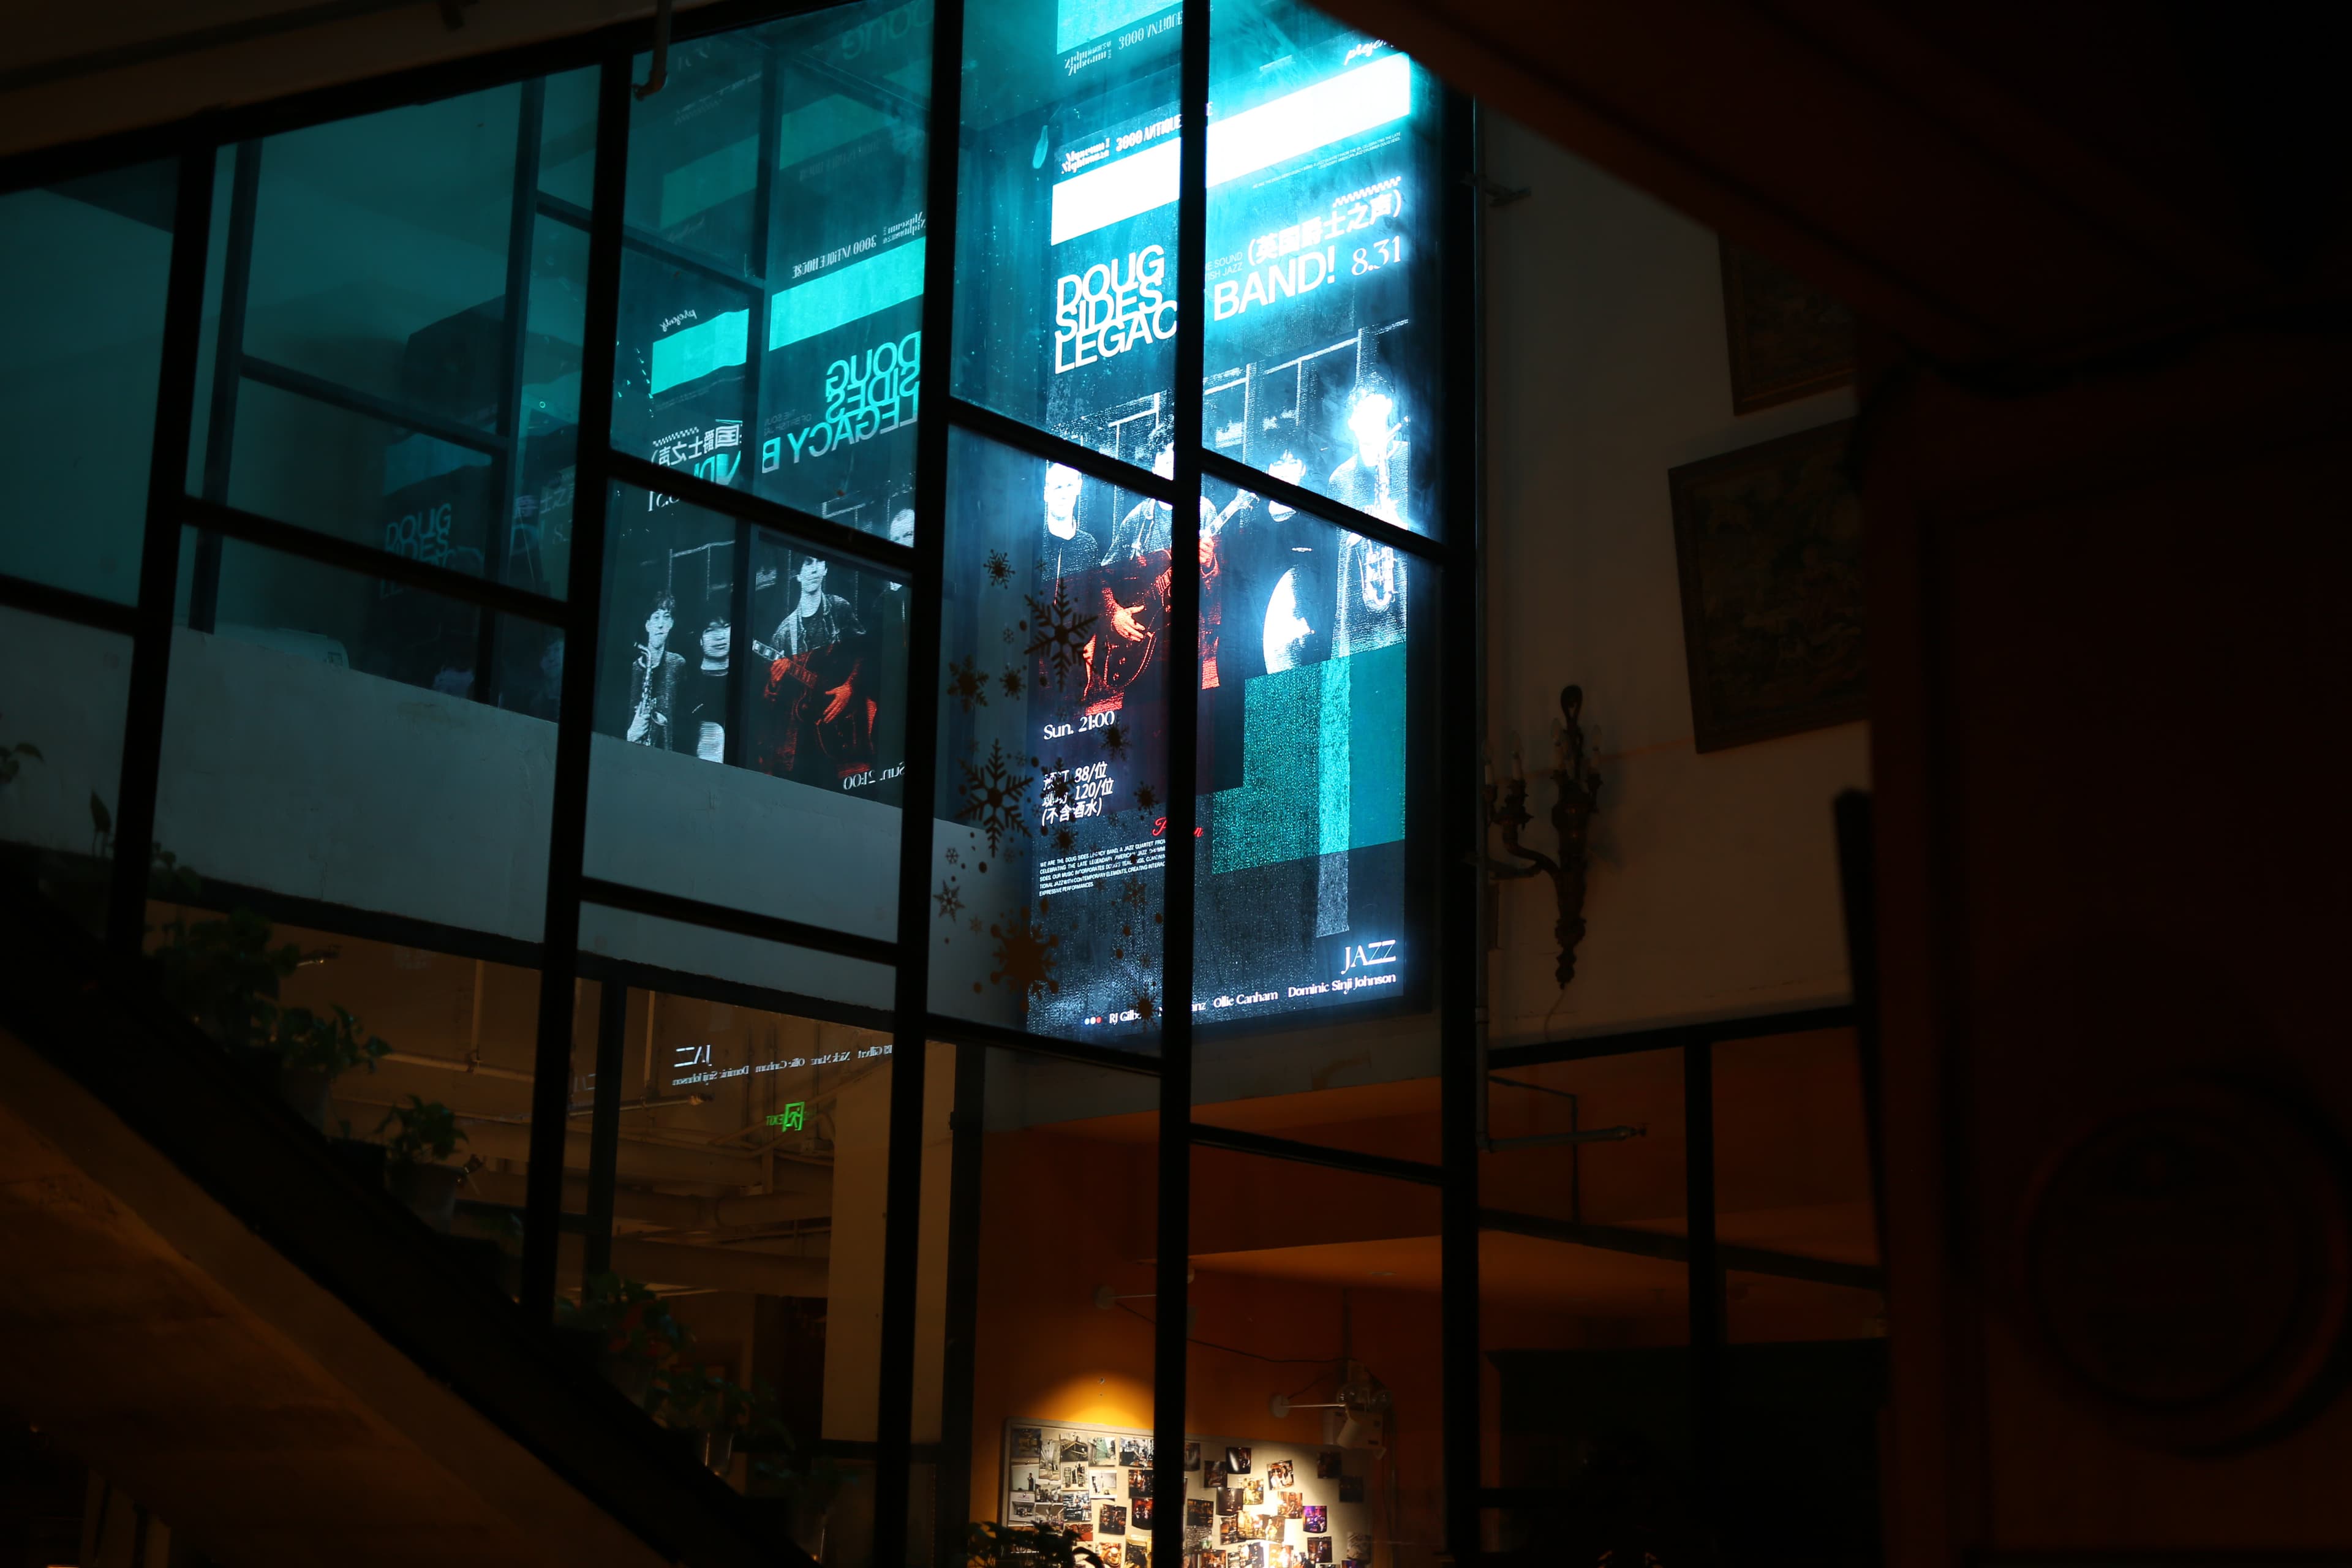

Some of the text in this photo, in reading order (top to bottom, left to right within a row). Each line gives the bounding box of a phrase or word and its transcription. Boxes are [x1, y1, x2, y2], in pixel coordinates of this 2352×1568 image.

[1115, 129, 1144, 152] 3000
[1214, 251, 1243, 268] SOUND
[1222, 262, 1243, 276] JAZZ
[1057, 244, 1164, 308] DOUG
[1054, 279, 1163, 343] SIDES
[1055, 235, 1401, 374] LEGAC BAND! 8.31
[1044, 710, 1115, 740] Sun. 21:00
[1074, 761, 1108, 783] 88/位
[1075, 777, 1114, 801] 120/位
[1042, 797, 1103, 827] (不含酒水)
[1341, 939, 1397, 974] JAZZ
[1109, 1013, 1118, 1025] RJ
[1213, 995, 1234, 1008] Ollie
[1236, 990, 1278, 1005] Canham
[1288, 982, 1330, 998] Dominic
[1332, 978, 1352, 995] Sinji
[1353, 974, 1396, 990] Johnson
